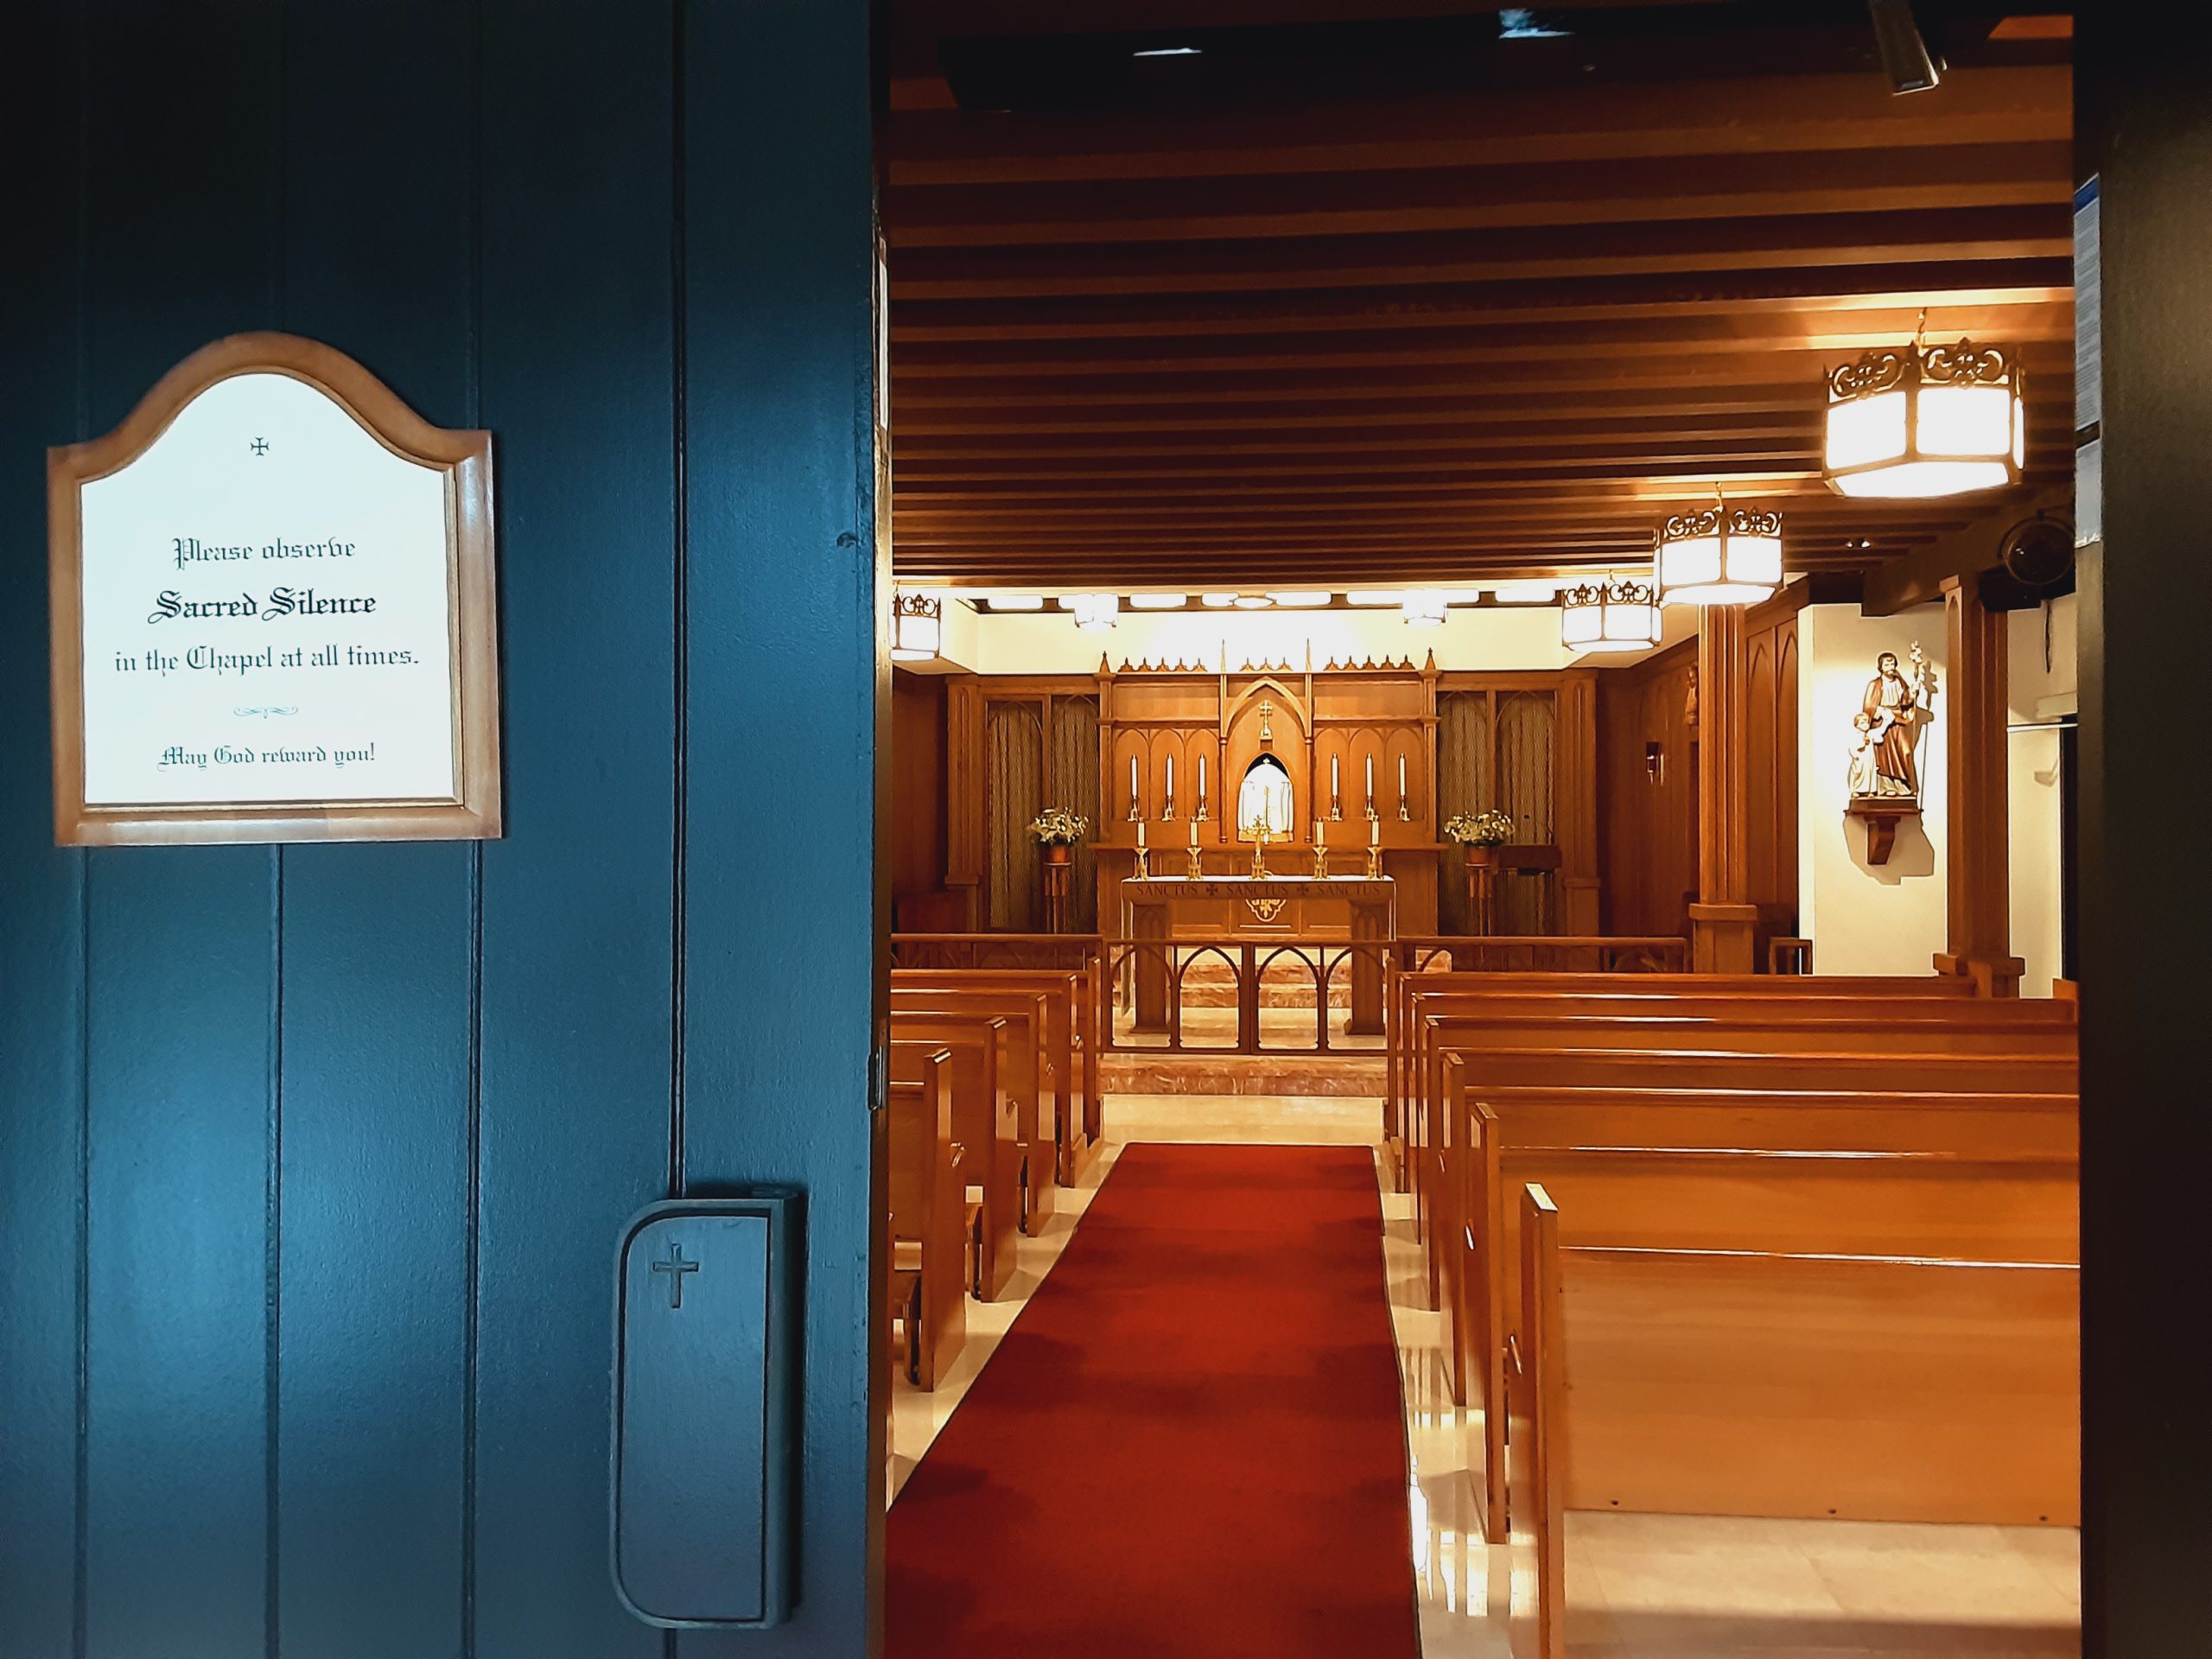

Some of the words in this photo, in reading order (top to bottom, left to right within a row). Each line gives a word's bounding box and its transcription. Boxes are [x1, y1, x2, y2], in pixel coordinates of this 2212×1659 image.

[171, 537, 253, 571] Please
[262, 536, 356, 560] observe
[146, 589, 258, 625] Sacred
[261, 586, 377, 622] Silence
[115, 650, 137, 672] in
[144, 649, 179, 677] the
[186, 645, 273, 677] Chapel
[279, 646, 303, 667] at
[310, 643, 339, 667] all
[346, 645, 419, 666] times.
[157, 745, 207, 771] May
[213, 745, 255, 765] God
[261, 746, 327, 763] reward
[333, 741, 375, 769] you!
[1136, 883, 1198, 896] SANCTUS
[1227, 884, 1288, 896] SANCTUS
[1318, 884, 1380, 896] SANCTUS
